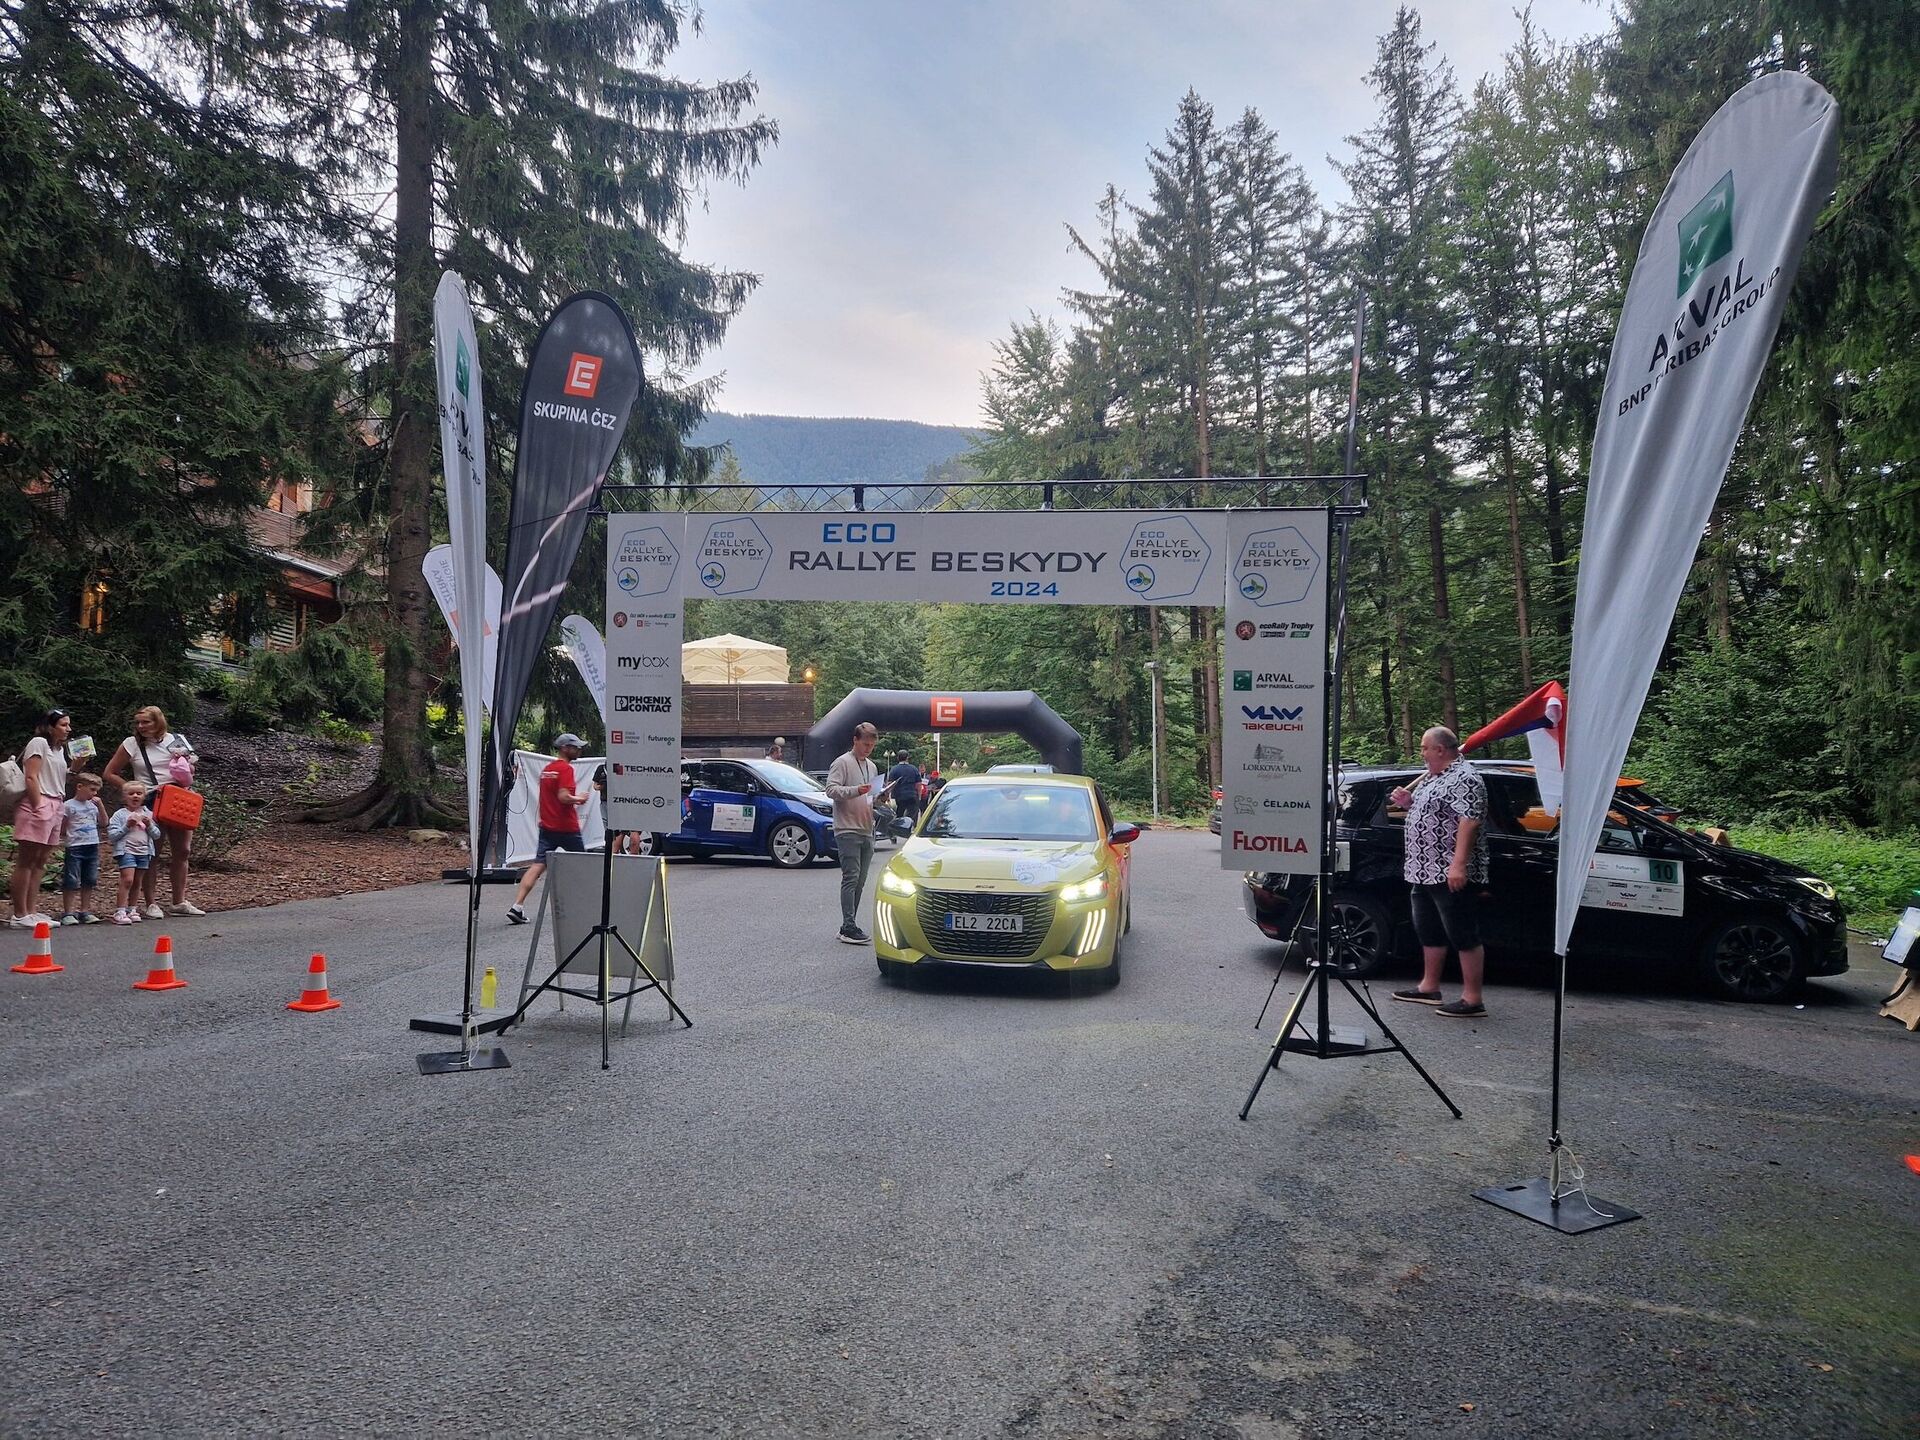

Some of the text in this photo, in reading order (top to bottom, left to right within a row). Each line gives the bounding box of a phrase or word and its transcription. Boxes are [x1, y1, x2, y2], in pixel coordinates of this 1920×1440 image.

[1648, 258, 1753, 373] ARVAL
[1618, 384, 1651, 417] BNP
[1722, 266, 1781, 329] GROUP
[534, 401, 617, 431] SKUPINA ČEZ
[823, 523, 896, 543] ECO
[710, 538, 754, 547] RALLYE
[1136, 539, 1189, 548] RALLYE
[704, 548, 764, 556] BESKYDY
[1130, 550, 1200, 558] BESKYDY
[1248, 549, 1299, 558] RALLYE
[789, 550, 1108, 572] RALLYE BESKYDY
[1243, 558, 1310, 568] BESKYDY
[990, 582, 1060, 596] 2024
[1259, 622, 1314, 630] ecoRally Trophy
[1256, 673, 1294, 682] ARVAL
[628, 704, 672, 712] CONTACT
[648, 734, 676, 746] futurego
[624, 765, 674, 774] TECHNIKA
[1243, 763, 1302, 773] LORKOVA VILA
[1264, 799, 1312, 809] ČELADNÁ
[1654, 864, 1673, 880] 10
[954, 916, 1017, 931] EL2 22CA
